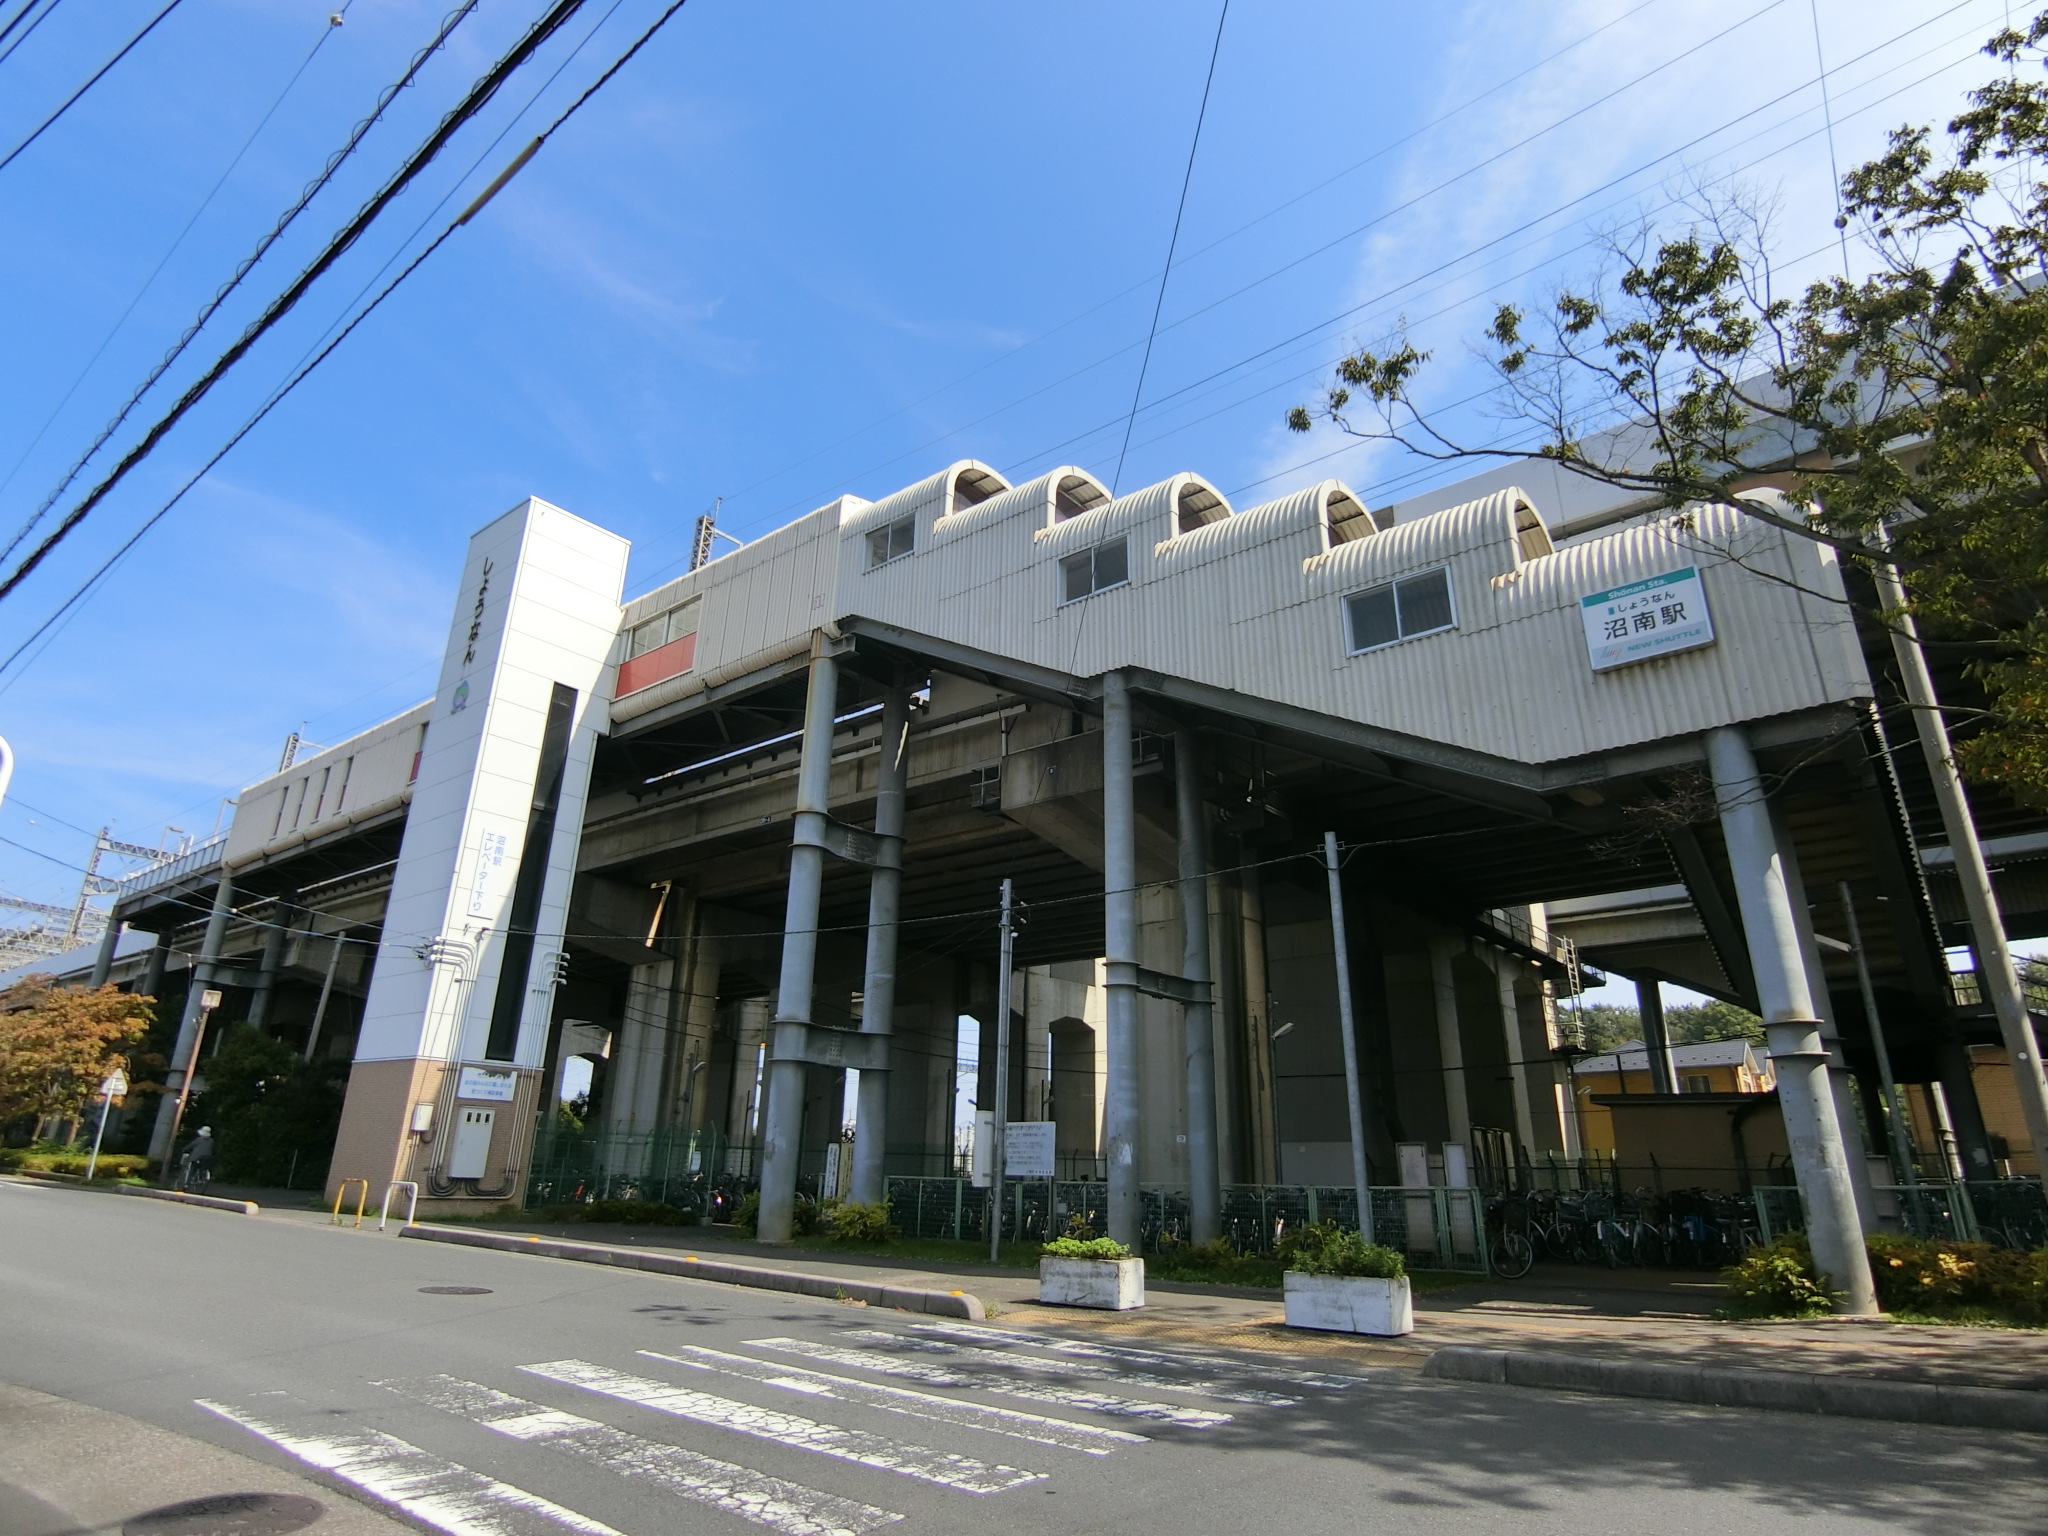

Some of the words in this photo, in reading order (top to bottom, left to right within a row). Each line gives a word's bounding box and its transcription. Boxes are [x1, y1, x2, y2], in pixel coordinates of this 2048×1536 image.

[1647, 579, 1668, 590] Sta.
[463, 557, 493, 666] しょうなん
[1618, 590, 1676, 613] しょうなん
[1603, 602, 1687, 640] 沼南駅
[1628, 640, 1652, 651] NEW
[1654, 628, 1702, 645] SHUTTLE
[493, 835, 506, 867] 沼南駅
[473, 833, 495, 911] エレベーター下り
